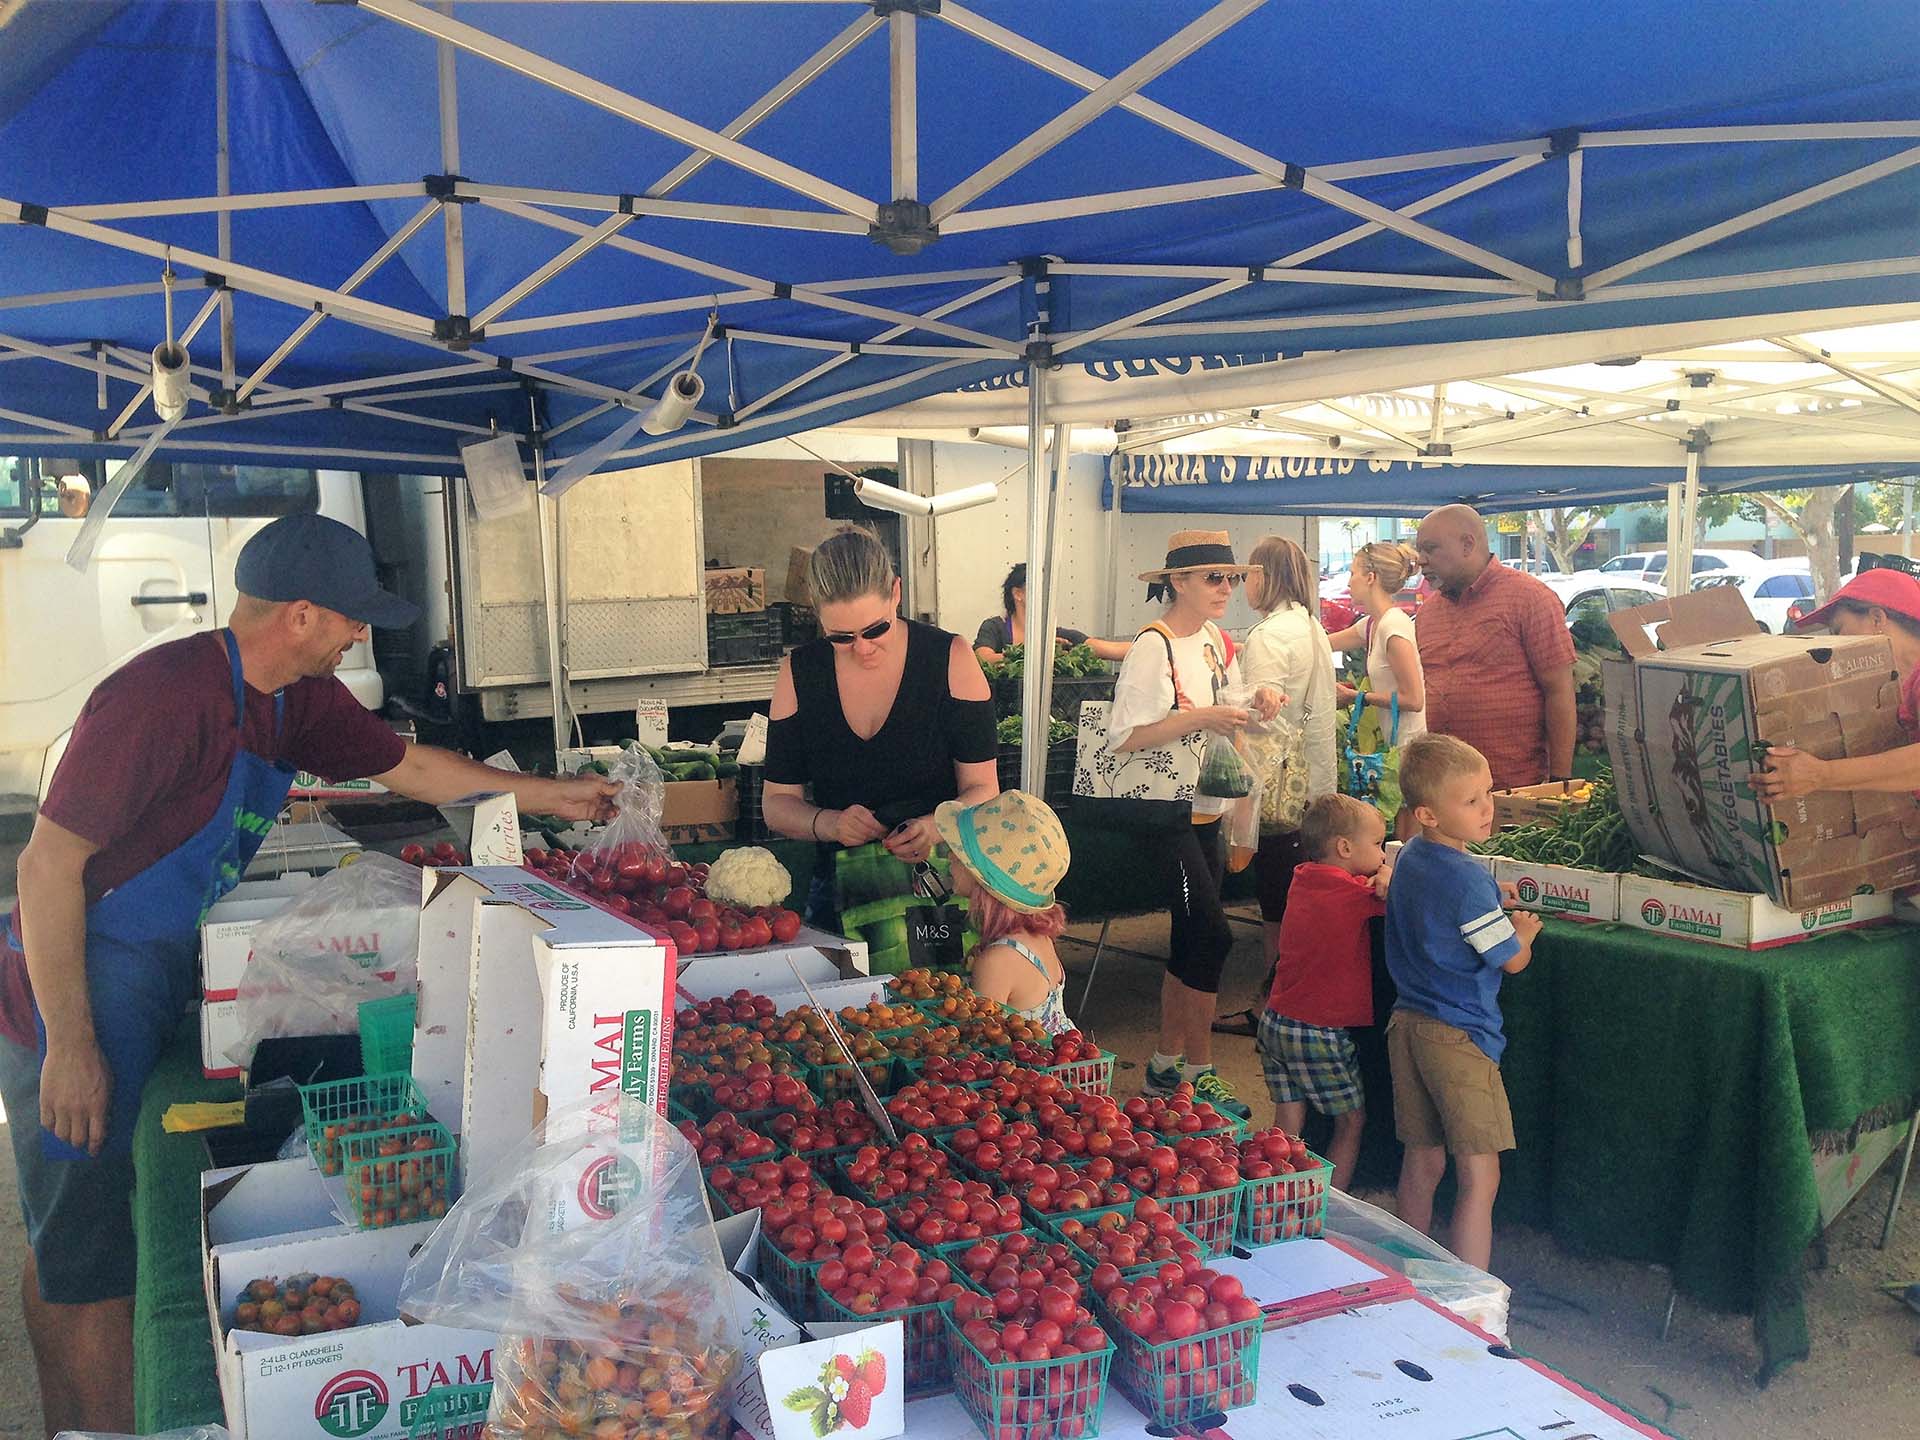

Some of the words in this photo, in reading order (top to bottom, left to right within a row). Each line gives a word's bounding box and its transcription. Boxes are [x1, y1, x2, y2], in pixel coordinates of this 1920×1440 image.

[1711, 705, 1740, 832] VEGETABLES
[1542, 881, 1591, 901] TAMAI
[1669, 904, 1723, 926] TAMAI
[311, 932, 381, 954] AMAI
[915, 924, 950, 940] M&S
[562, 962, 569, 973] OF
[559, 973, 568, 1012] PRODUCE
[627, 1015, 645, 1073] Farms
[661, 1016, 672, 1053] EATING
[658, 1056, 669, 1103] HEALTHY
[288, 1343, 344, 1361] CLAMSHELLS
[291, 1360, 303, 1369] PT
[304, 1353, 343, 1367] BASKETS
[396, 1348, 495, 1398] TAM
